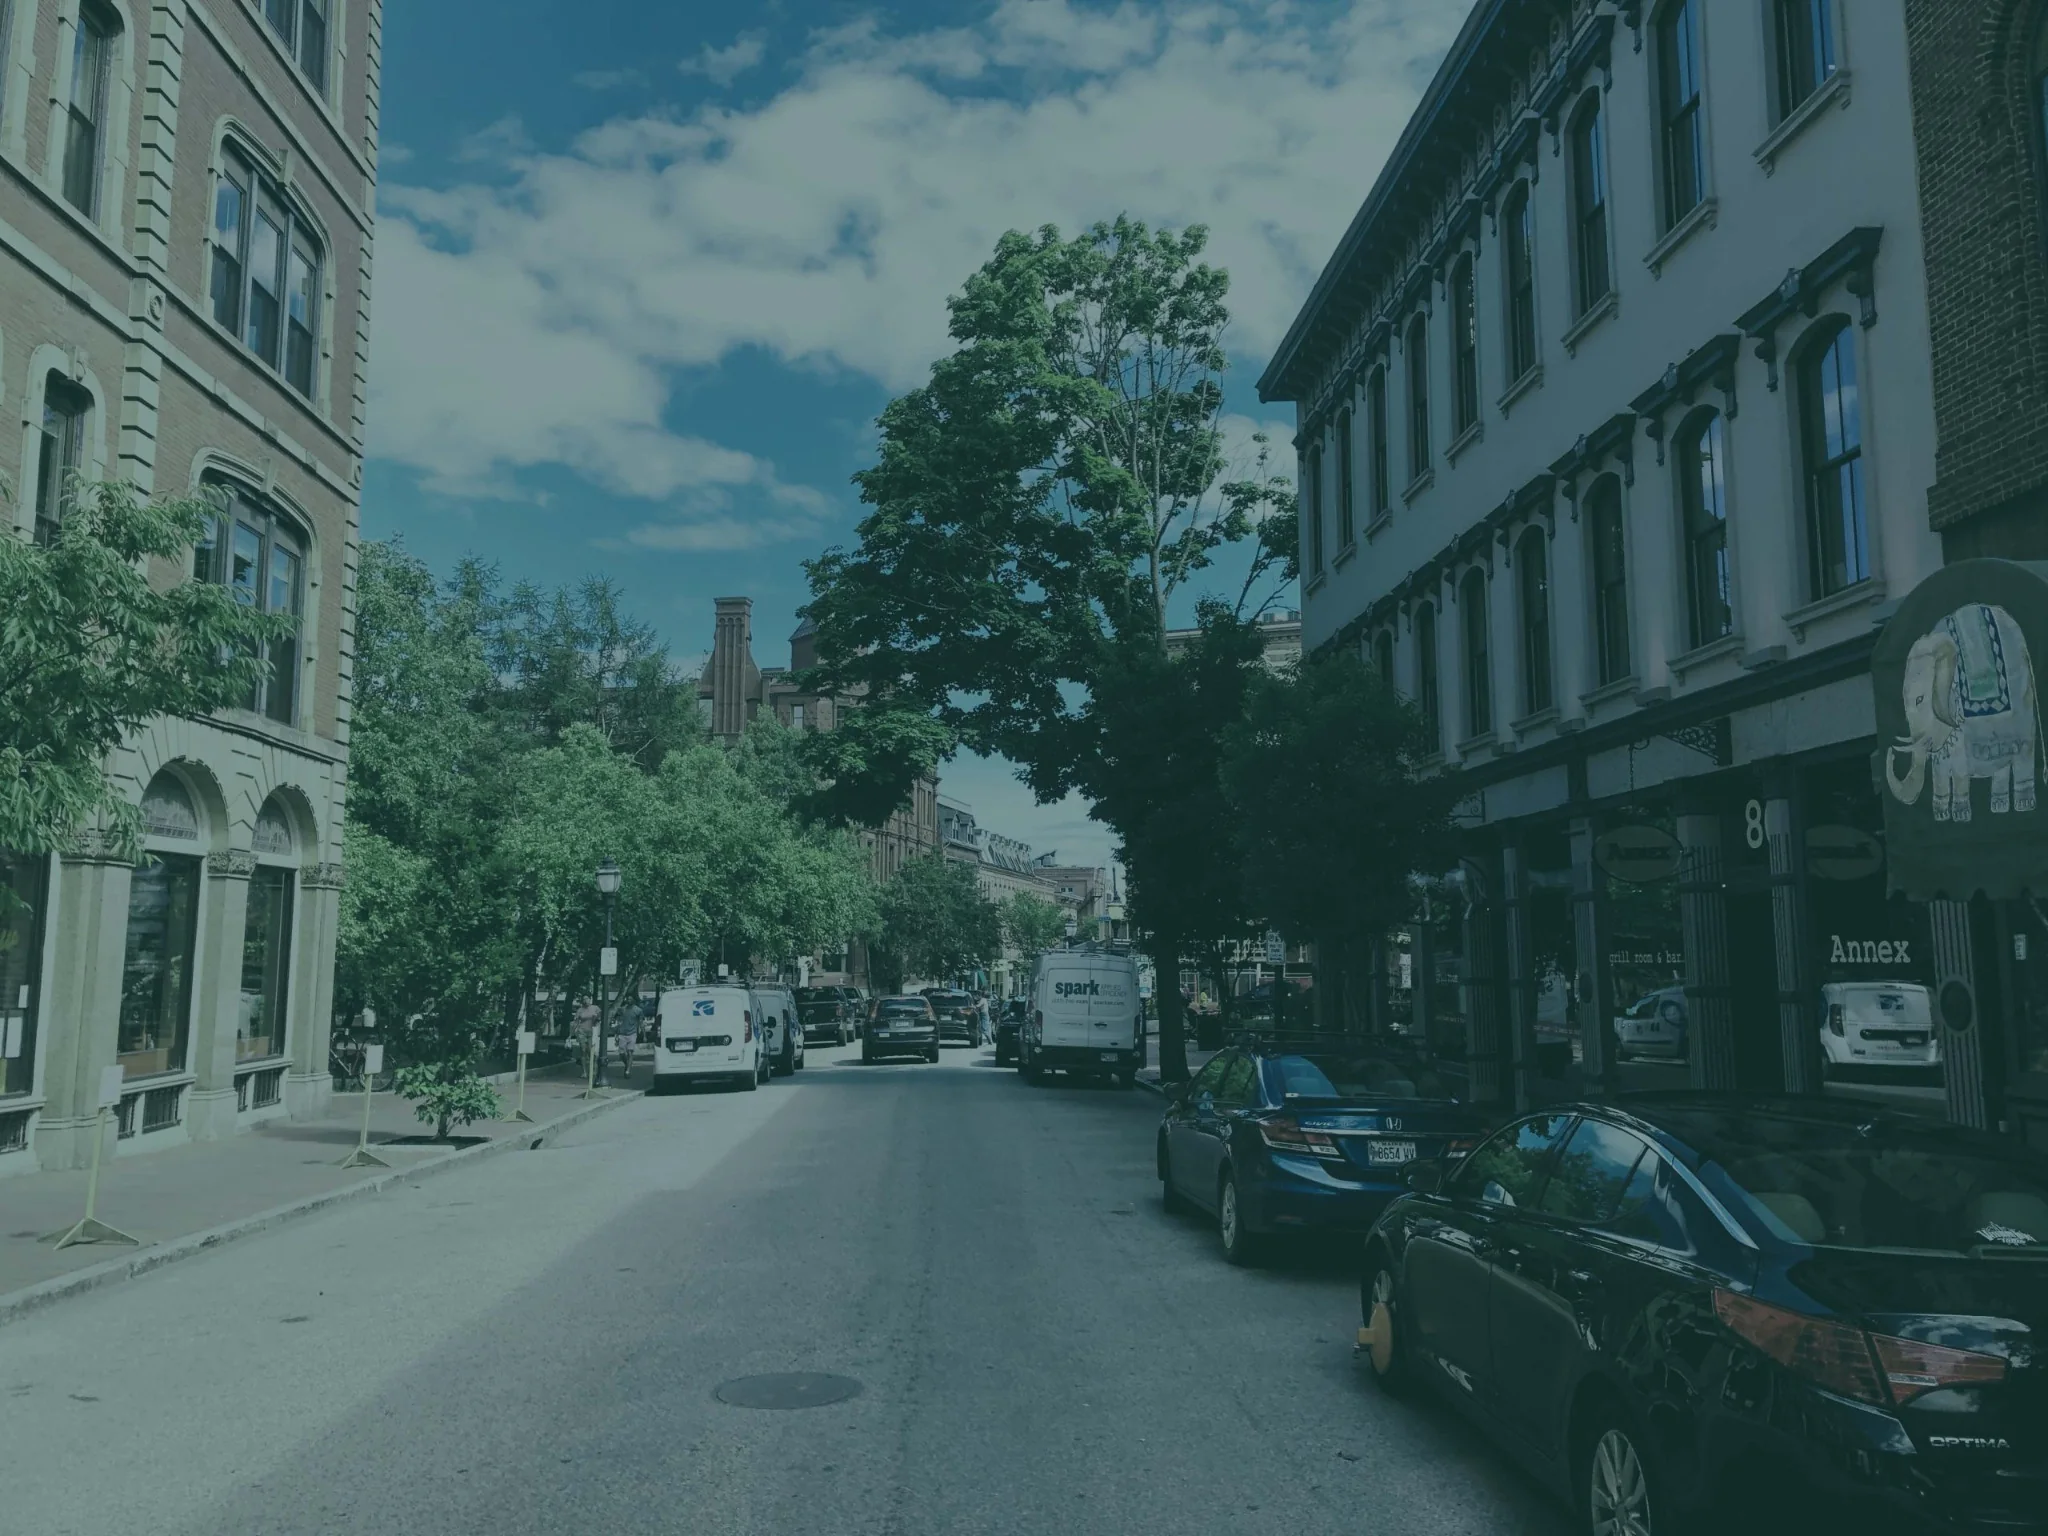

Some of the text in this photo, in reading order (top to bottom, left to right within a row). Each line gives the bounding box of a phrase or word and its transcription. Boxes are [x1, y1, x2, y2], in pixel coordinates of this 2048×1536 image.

[1744, 798, 1764, 849] 8
[1830, 934, 1911, 963] Annex
[1609, 950, 1630, 967] grill
[1634, 953, 1653, 964] room
[1055, 979, 1100, 998] spark
[1378, 1146, 1400, 1160] 8654
[1928, 1436, 2011, 1449] OPTIMA
